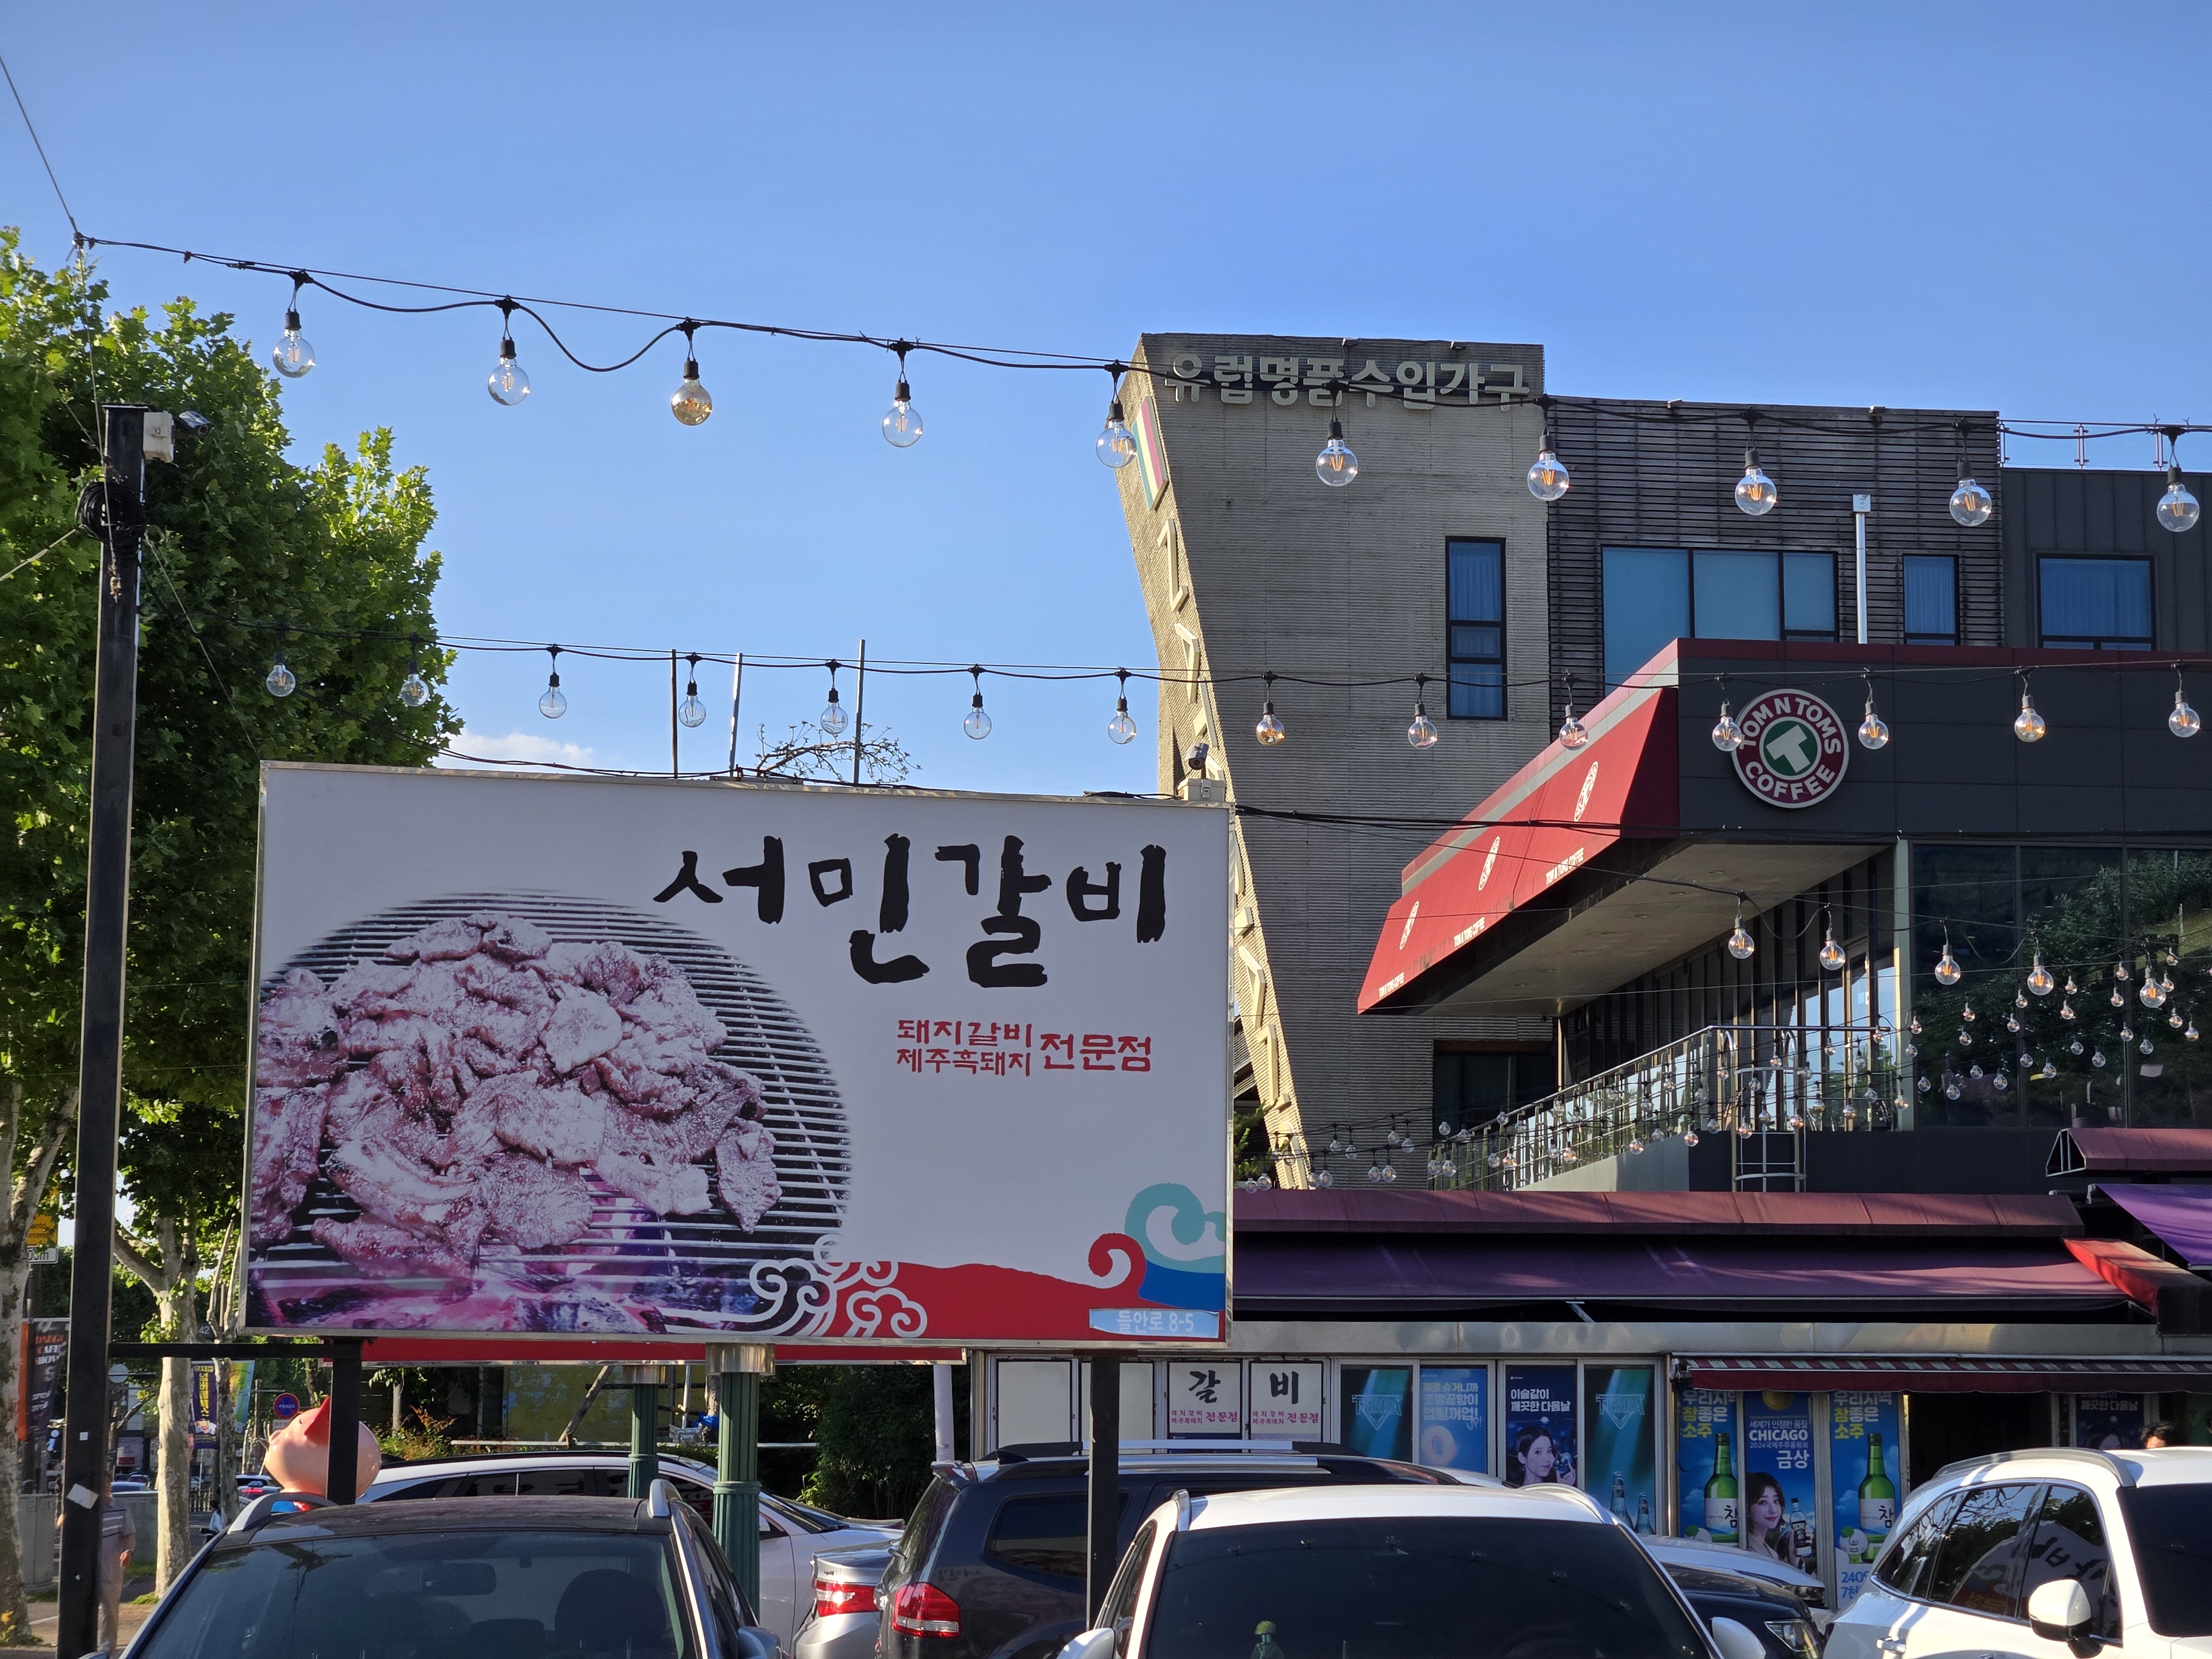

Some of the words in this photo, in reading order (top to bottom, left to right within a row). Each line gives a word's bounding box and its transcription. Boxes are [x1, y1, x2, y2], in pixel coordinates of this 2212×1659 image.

[1739, 703, 1774, 750] TOM
[1774, 697, 1791, 714] N
[1795, 697, 1841, 754] TOMS
[1745, 761, 1835, 800] COFFEE
[653, 833, 1166, 988] 서민갈비
[897, 1019, 1032, 1048] 돼지갈비
[896, 1048, 1031, 1077] 제주흑돼지
[1040, 1033, 1151, 1072] 전문점
[199, 1326, 210, 1334] 42
[1117, 1310, 1164, 1334] 들안로
[1168, 1311, 1194, 1332] 8-5
[1188, 1370, 1221, 1404] 갈
[1270, 1371, 1299, 1405] 비
[1511, 1389, 1549, 1400] 이슬같이
[1352, 1395, 1402, 1416] TERRA
[1511, 1401, 1540, 1412] 깨끗한
[1541, 1401, 1571, 1412] 다음날
[1595, 1394, 1645, 1416] TERRA
[1206, 1411, 1238, 1422] 전문점
[1287, 1412, 1318, 1423] 전문점
[1771, 1420, 1793, 1429] 인정한
[1682, 1422, 1713, 1438] 소주
[1749, 1430, 1808, 1441] CHICAGO
[1834, 1423, 1865, 1439] 소주
[1776, 1449, 1810, 1469] 금상
[1879, 1505, 1896, 1528] 참
